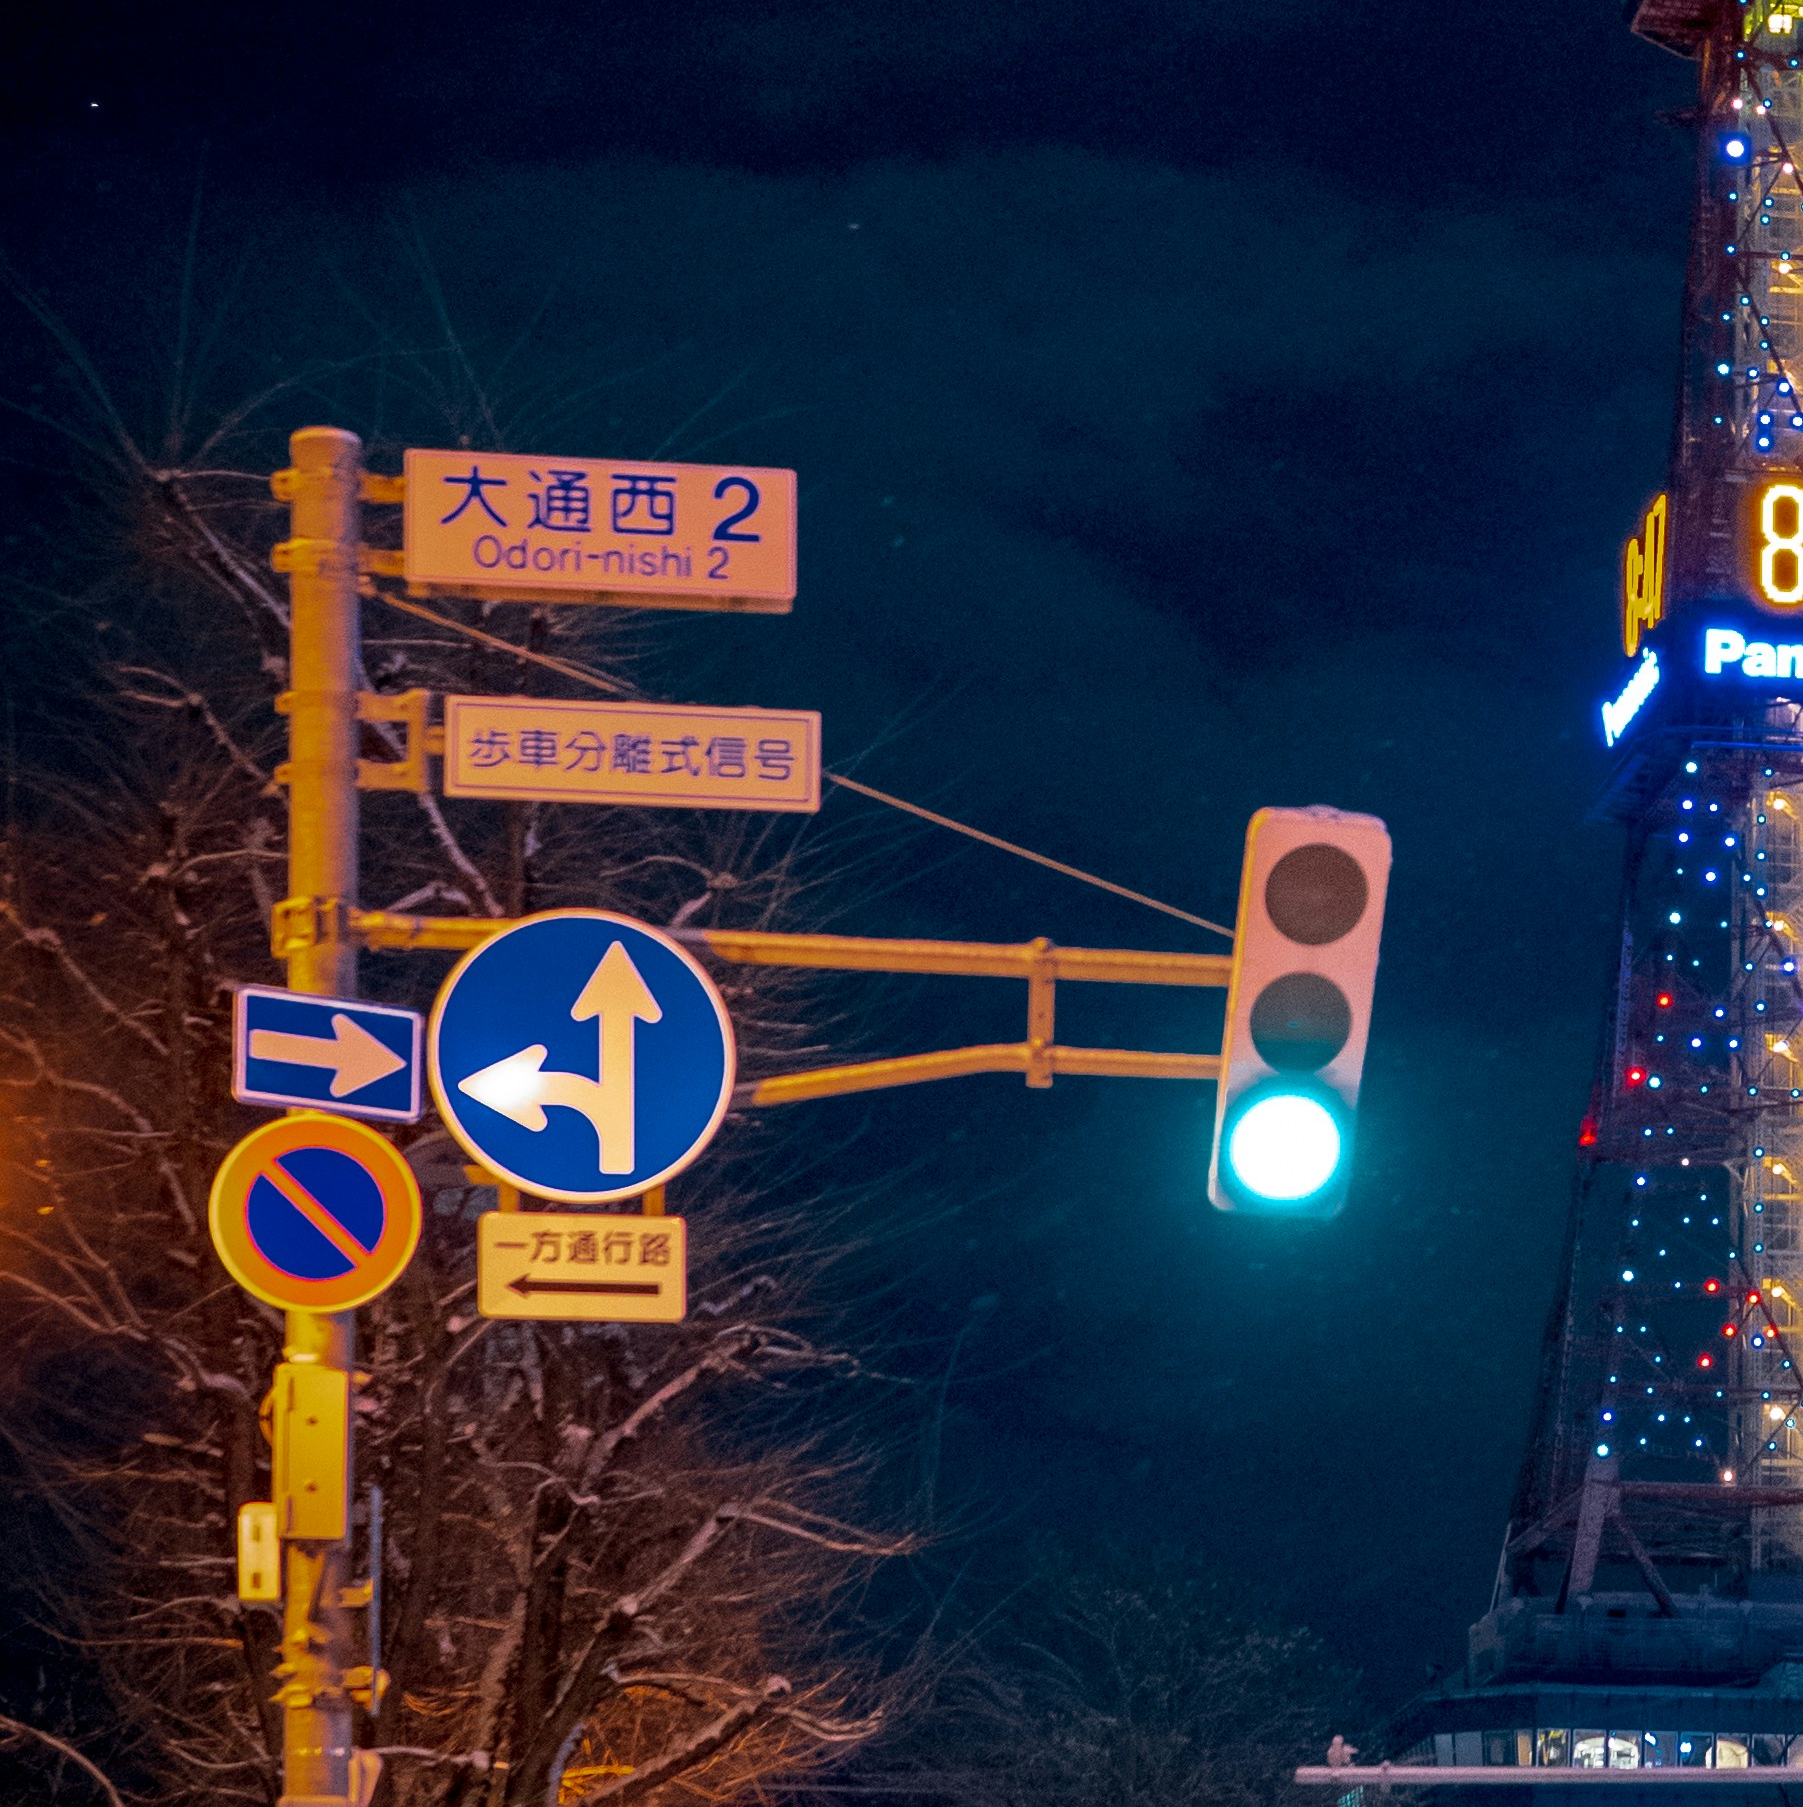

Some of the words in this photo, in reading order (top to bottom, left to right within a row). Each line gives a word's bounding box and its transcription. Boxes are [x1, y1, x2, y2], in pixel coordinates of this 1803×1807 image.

[473, 535, 692, 578] Odori-nishi
[706, 545, 730, 580] 2
[466, 727, 796, 783] 歩車分離式信号
[494, 1229, 673, 1268] 一方通行路
